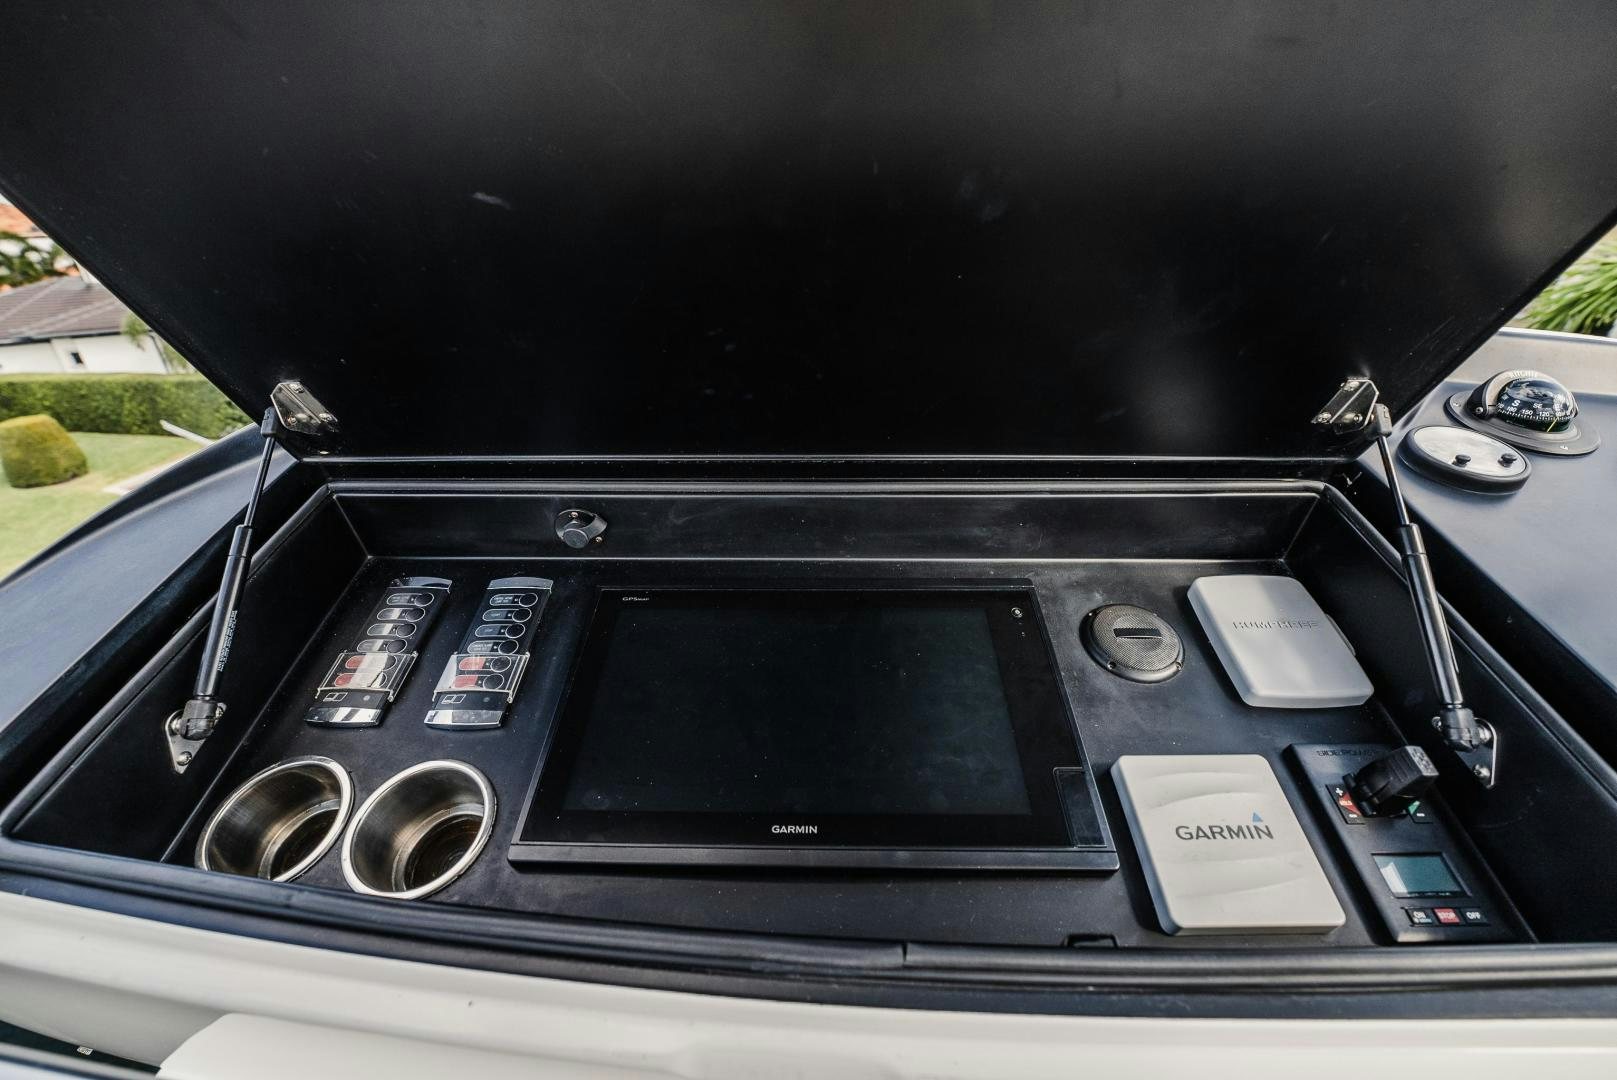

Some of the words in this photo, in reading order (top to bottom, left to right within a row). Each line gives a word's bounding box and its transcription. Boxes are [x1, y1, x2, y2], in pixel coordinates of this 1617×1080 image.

[771, 825, 818, 834] GARMIN
[1175, 825, 1274, 840] GARMIN
[1466, 911, 1481, 920] OFF
